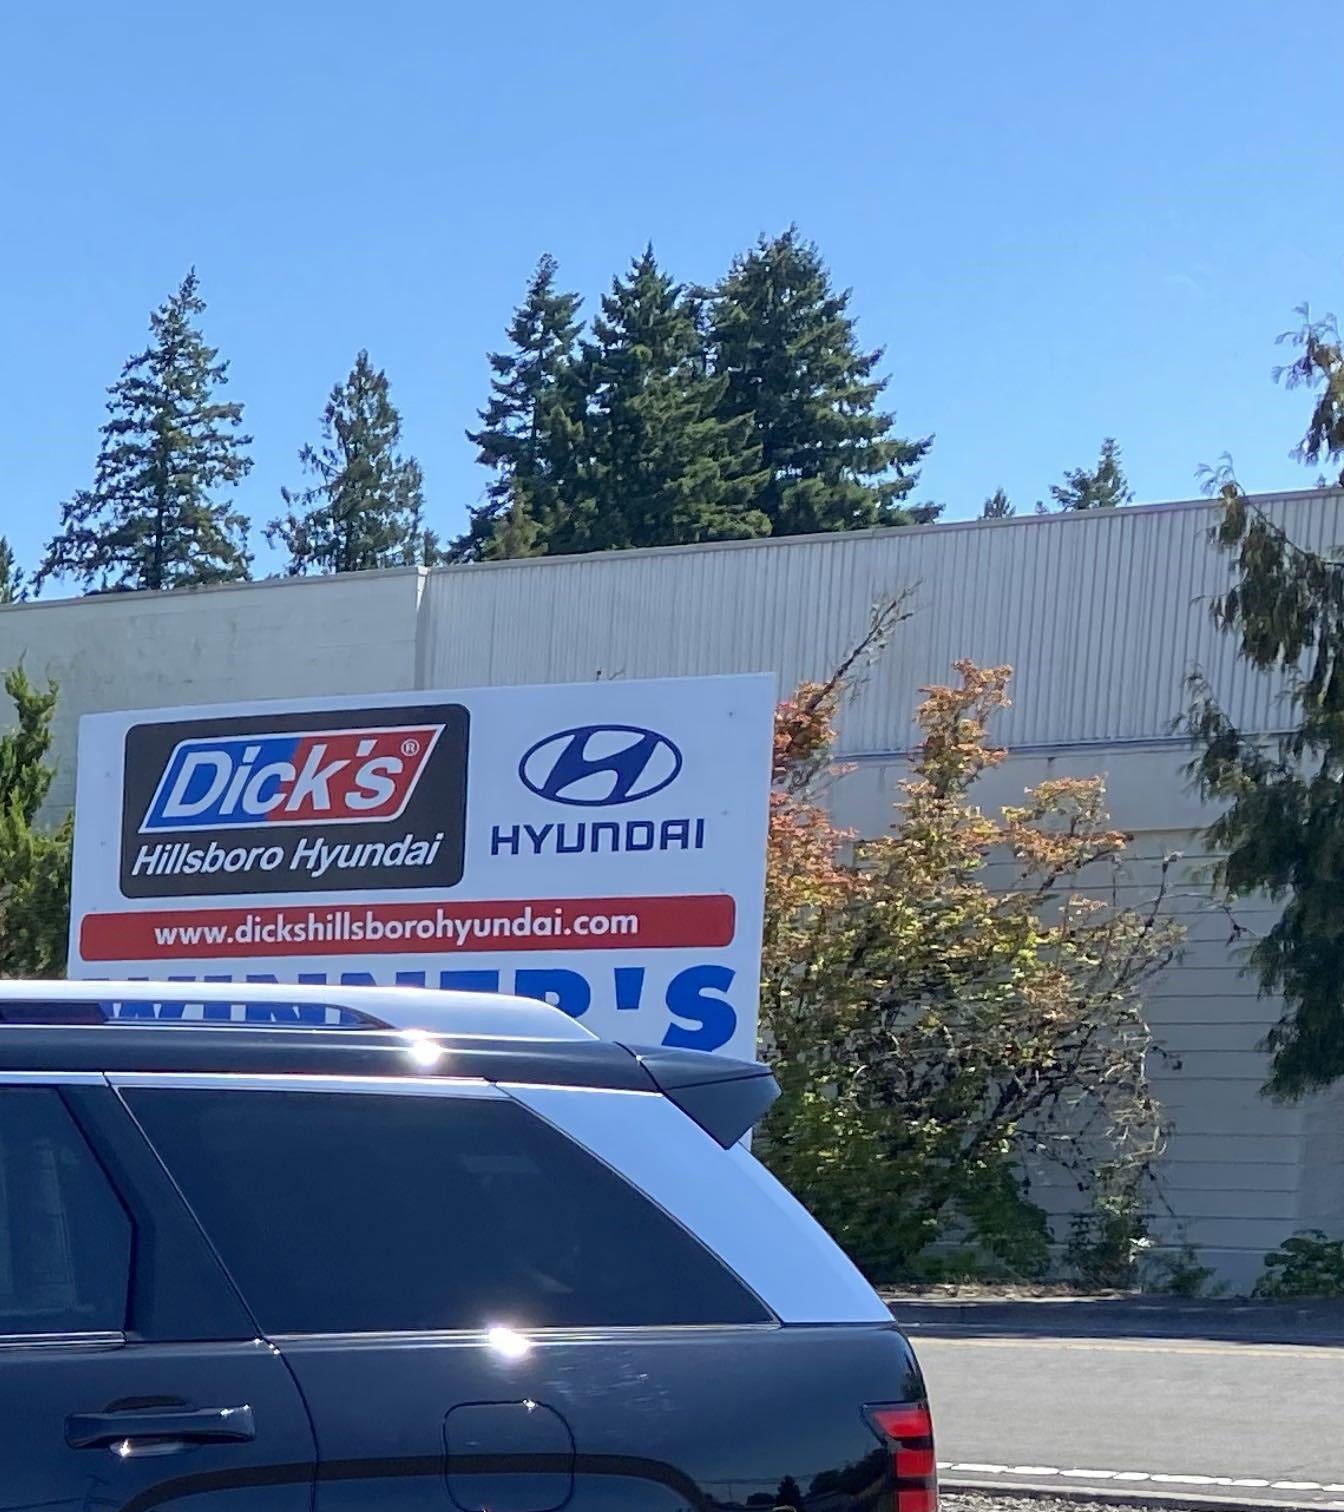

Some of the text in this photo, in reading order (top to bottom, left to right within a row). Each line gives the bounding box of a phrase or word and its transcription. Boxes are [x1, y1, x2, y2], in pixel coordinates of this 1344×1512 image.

[161, 739, 404, 819] Dick's
[131, 833, 445, 878] Hillsboro Hyundai
[490, 818, 705, 856] HYUNDAI
[154, 907, 639, 946] www.dickshillsborohyundai.com
